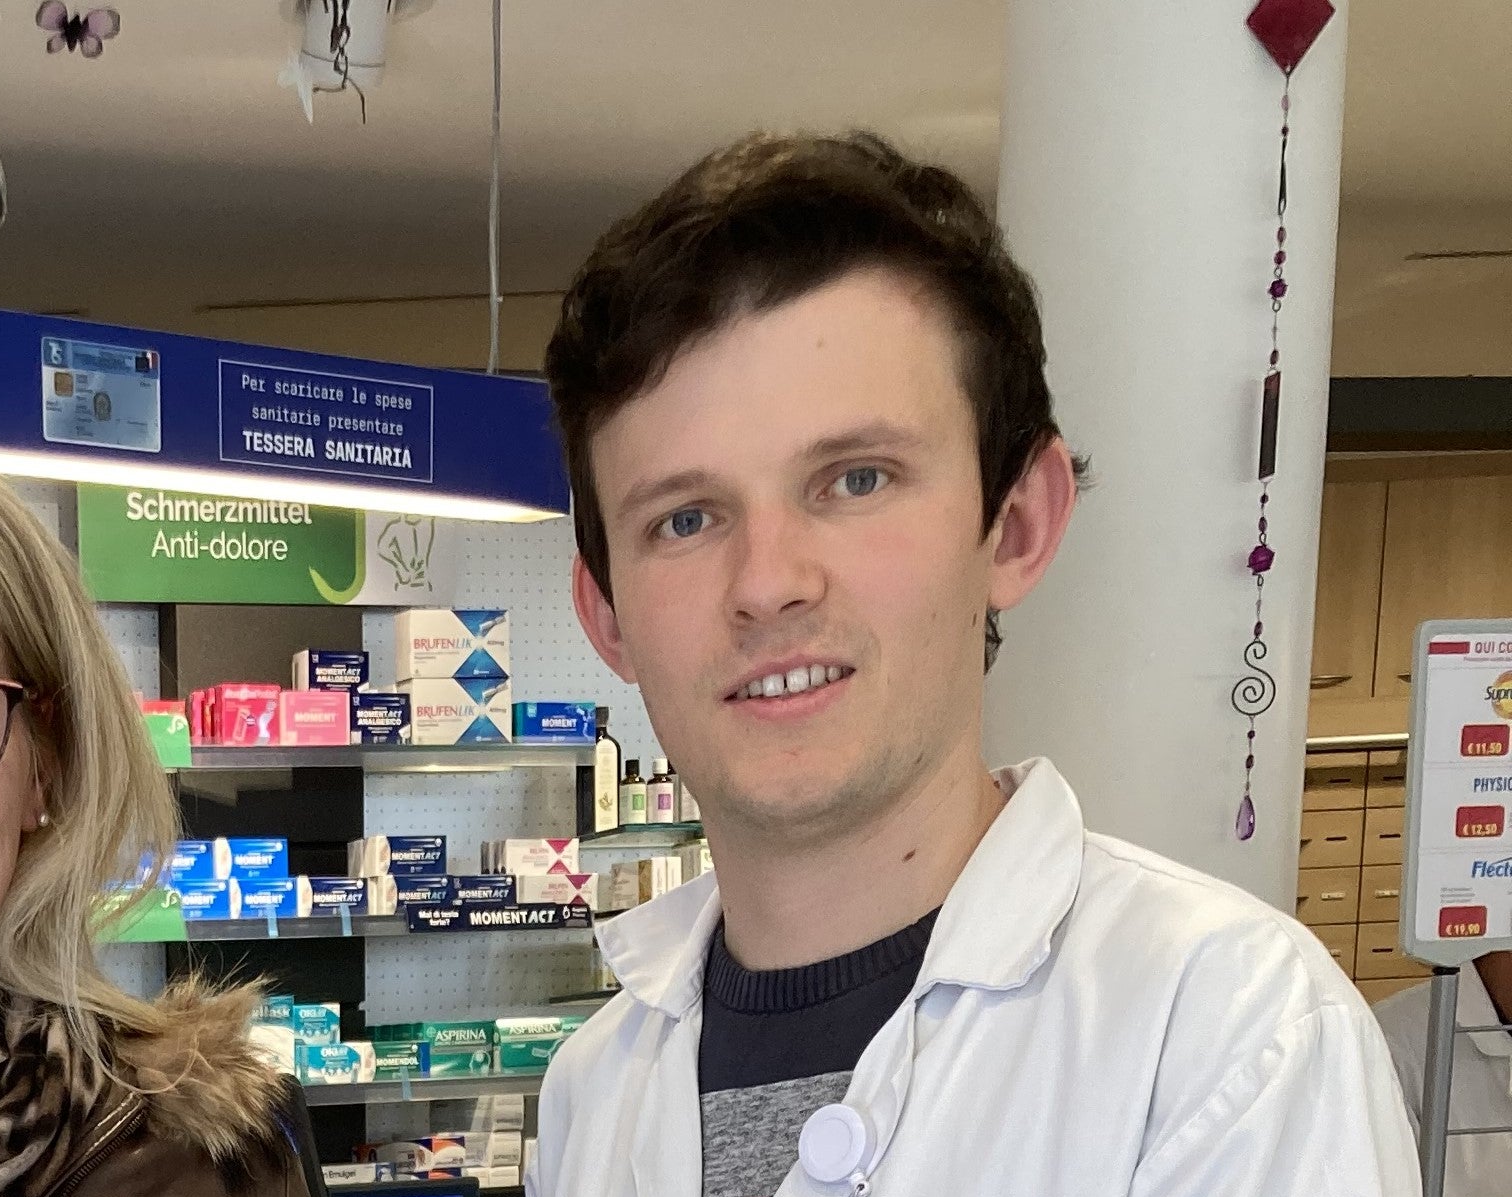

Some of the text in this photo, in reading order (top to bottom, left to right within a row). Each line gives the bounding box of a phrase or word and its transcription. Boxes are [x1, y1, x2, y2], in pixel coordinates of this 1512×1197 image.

[241, 374, 413, 412] Per scaricare le spese
[252, 403, 404, 437] sanitarie presentare
[242, 430, 413, 469] TESSERA SANITARIA
[126, 492, 313, 525] Schmerzmittel
[152, 530, 289, 562] Anti-dolore
[1475, 641, 1495, 654] QUI
[294, 713, 337, 724] MOMENT
[541, 718, 578, 728] MOMENT
[392, 852, 441, 861] MOMENTACT
[313, 893, 362, 903] MOMENTACT
[398, 891, 446, 901] MOMENTACT
[458, 889, 509, 899] MOMENTACT
[470, 910, 555, 926] MOMENTACT
[434, 1029, 487, 1041] ASPIRINA
[510, 1024, 557, 1035] ASPIRINA
